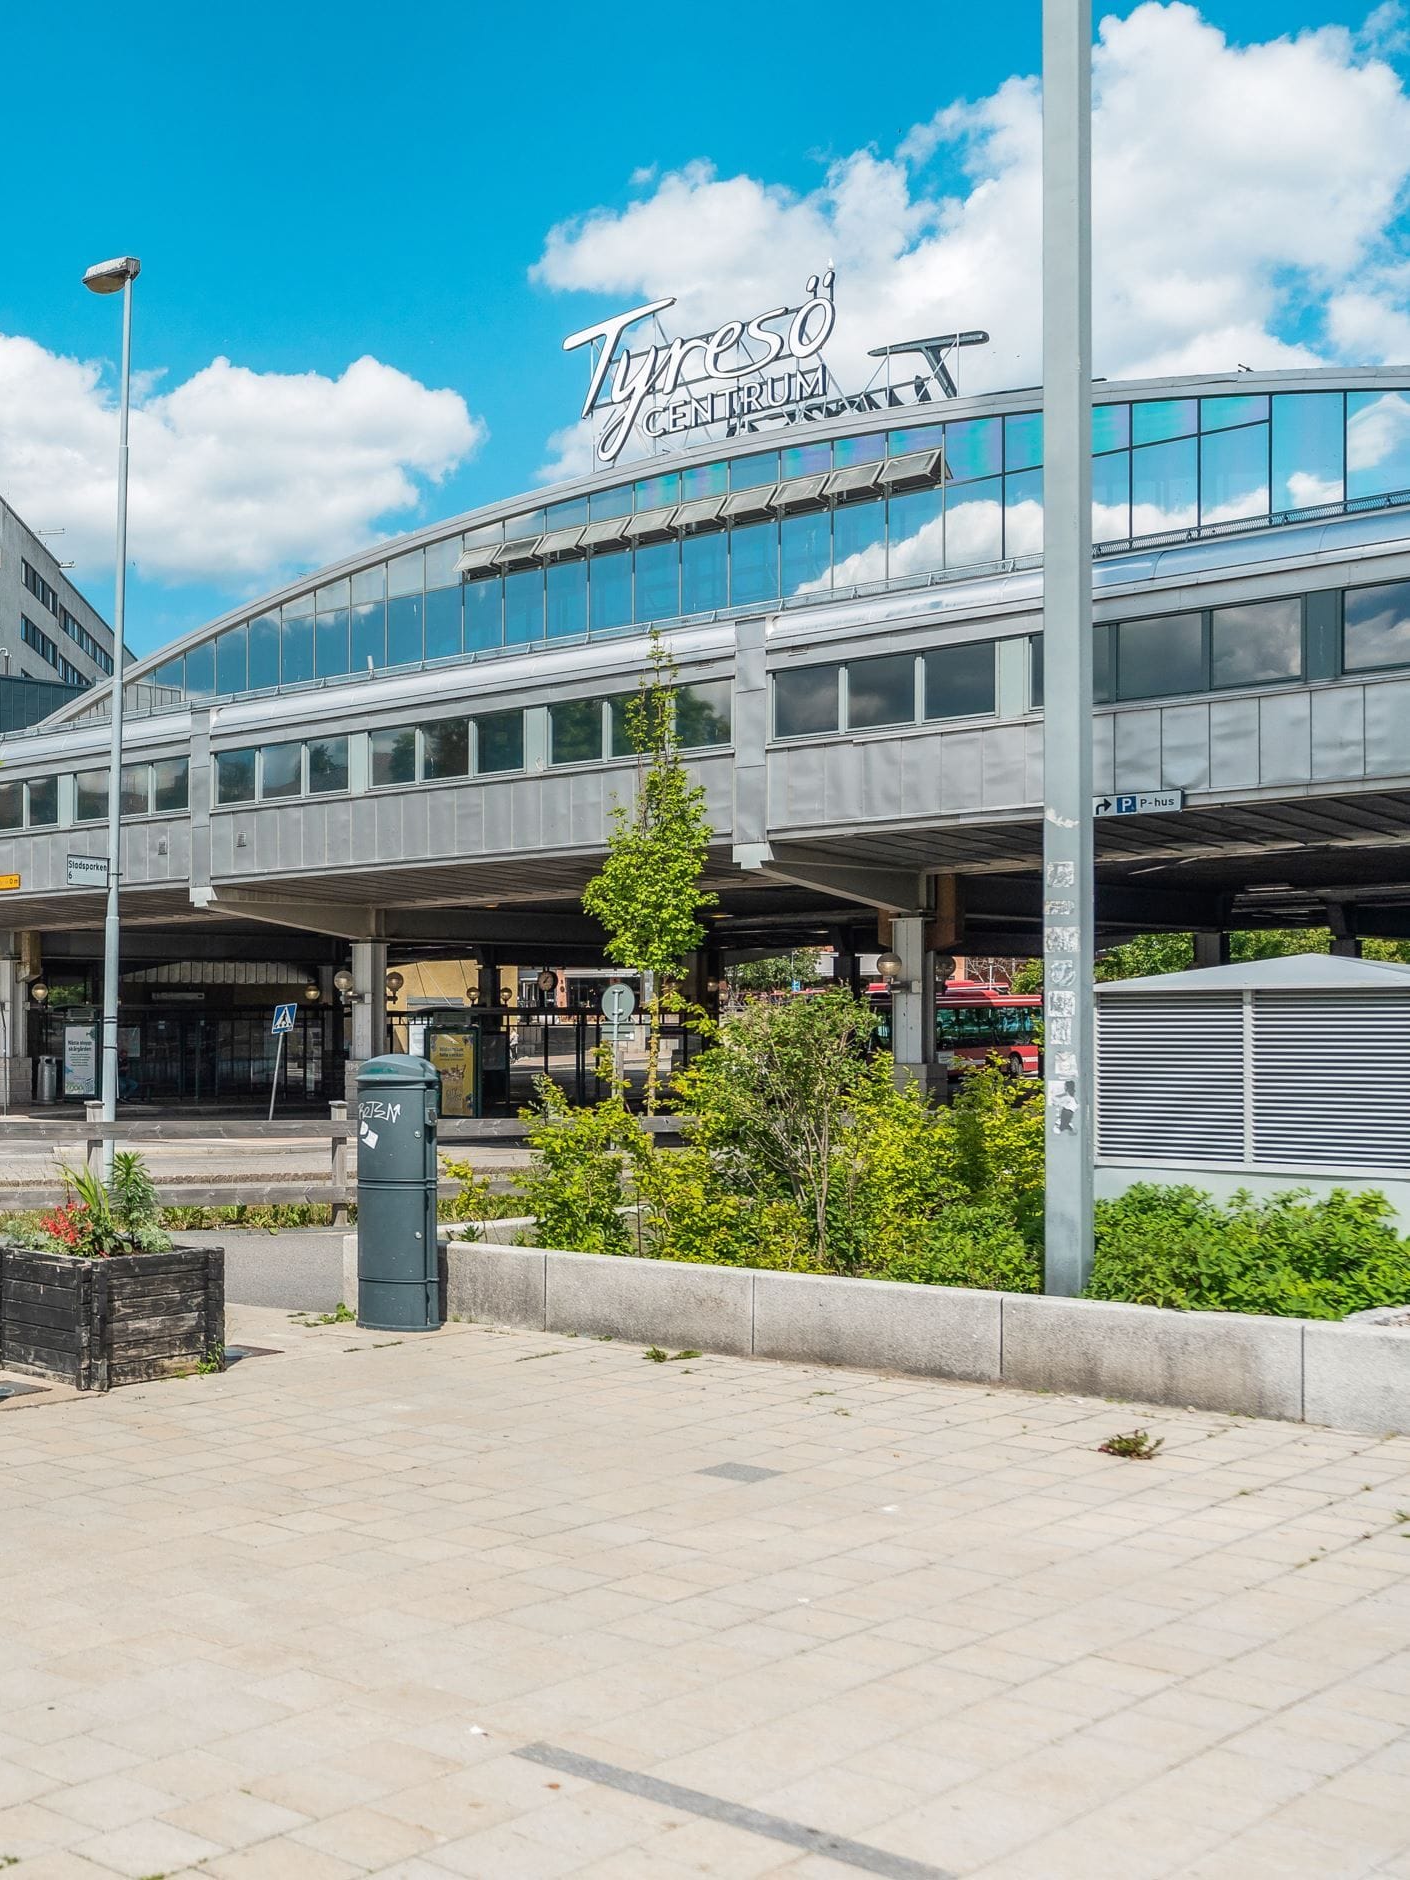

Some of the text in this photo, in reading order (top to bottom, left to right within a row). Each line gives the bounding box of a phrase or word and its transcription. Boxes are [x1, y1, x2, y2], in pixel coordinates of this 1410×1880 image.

[562, 270, 836, 462] Tyresö
[641, 363, 829, 438] CENTRUM
[1140, 797, 1175, 808] P-hus
[68, 860, 108, 871] Stadsparken
[68, 871, 73, 879] 6
